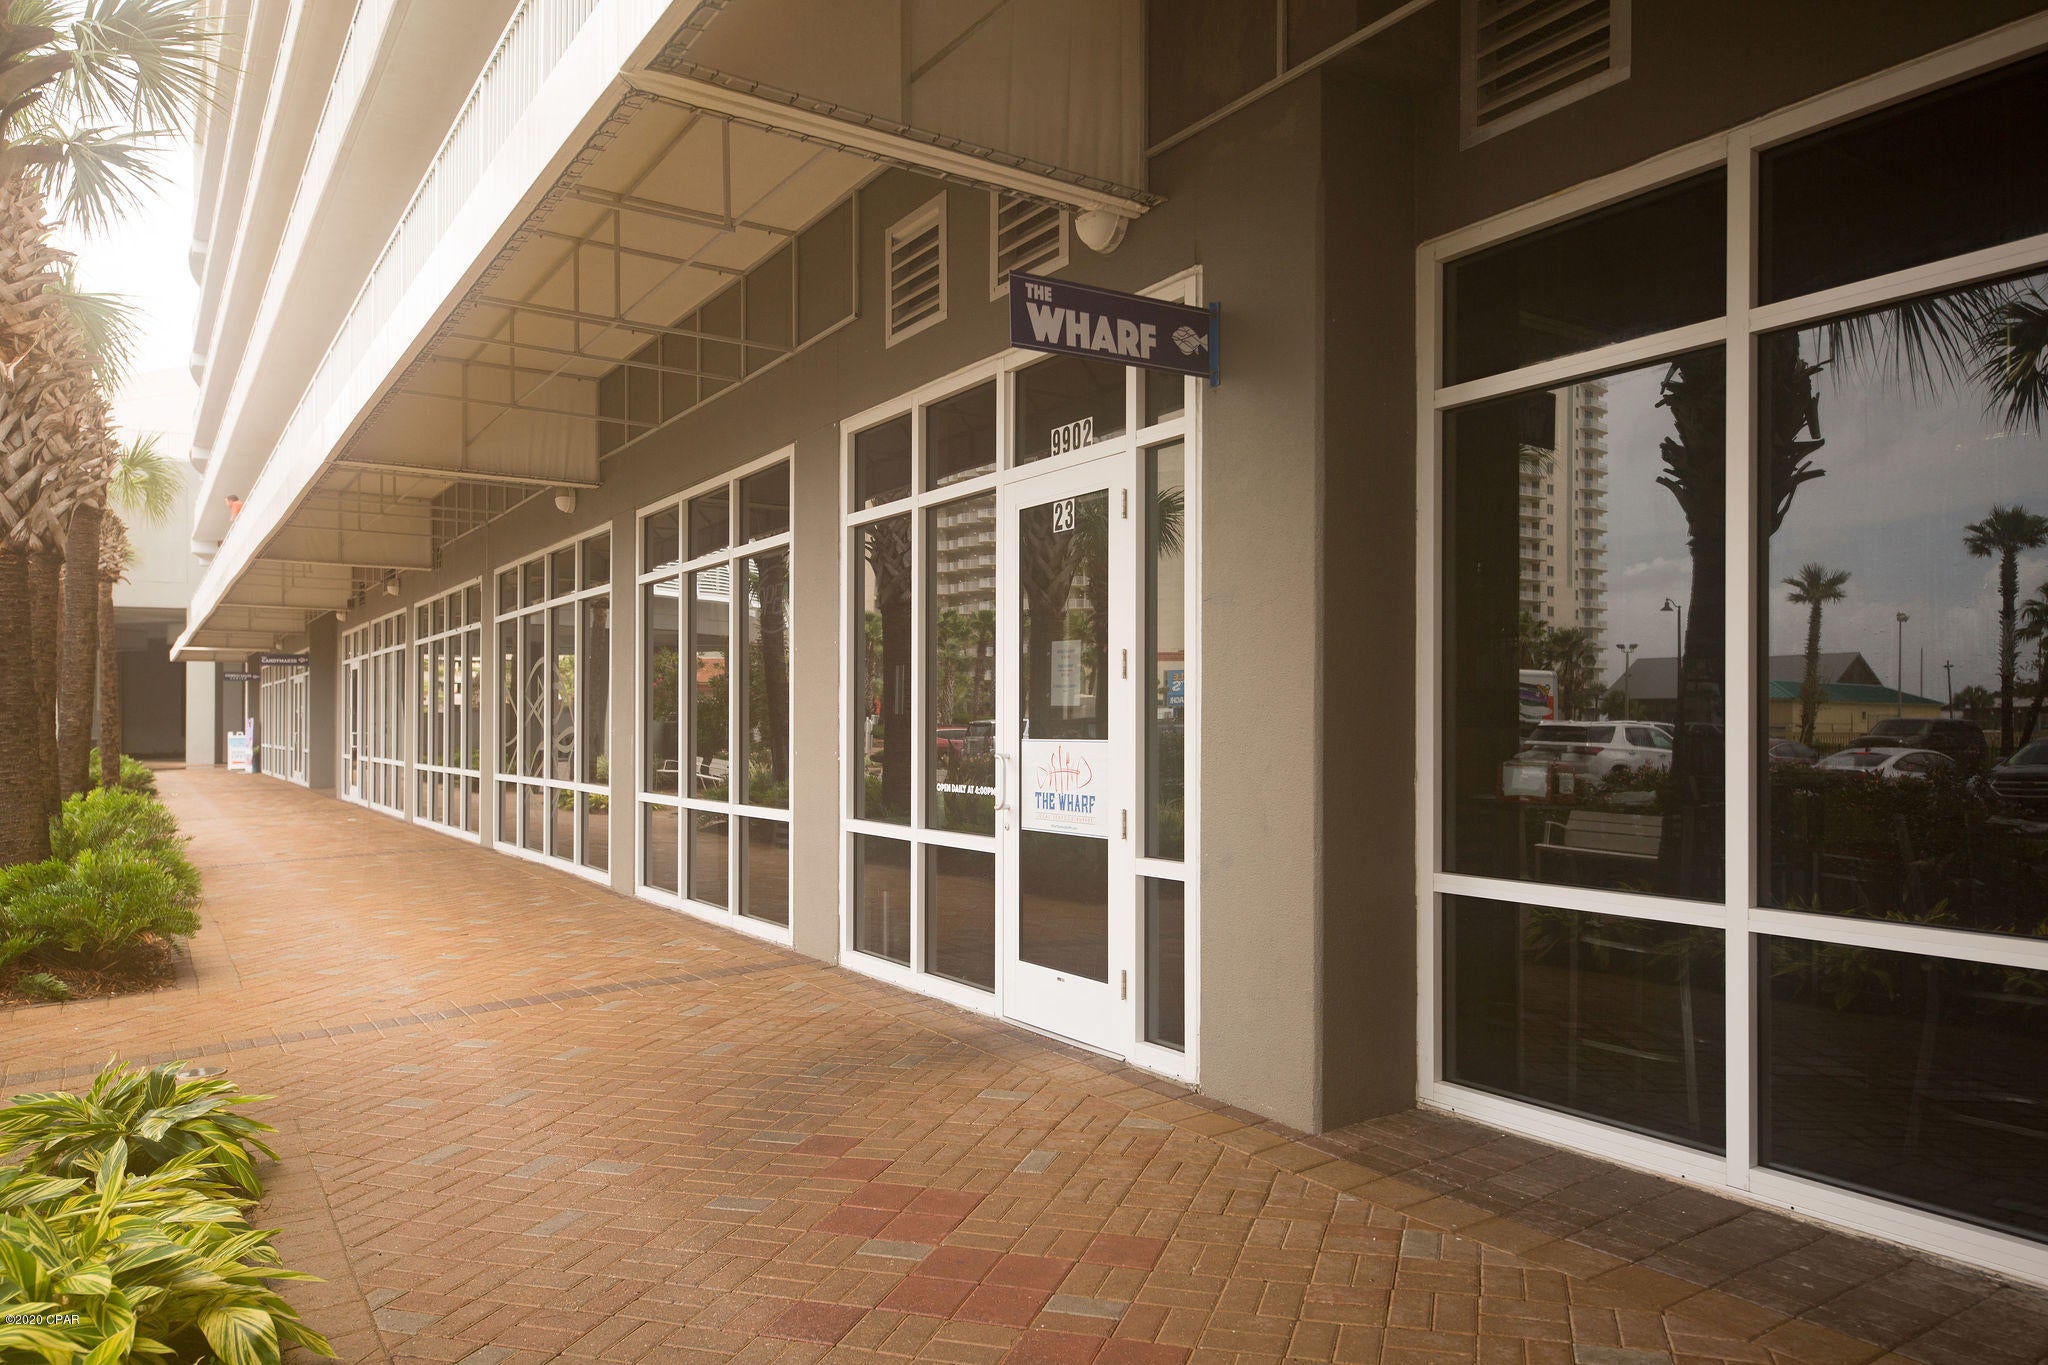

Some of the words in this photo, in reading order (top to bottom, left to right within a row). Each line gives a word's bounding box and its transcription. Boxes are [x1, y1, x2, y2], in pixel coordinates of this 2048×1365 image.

[1024, 282, 1052, 302] THE
[1025, 301, 1157, 360] WHARF
[1052, 419, 1092, 457] 9902
[1054, 500, 1074, 531] 23
[936, 783, 951, 793] OPEN
[951, 783, 967, 794] DAILY
[967, 785, 975, 794] AT
[1034, 791, 1055, 810] THE
[1058, 793, 1096, 814] WHARF
